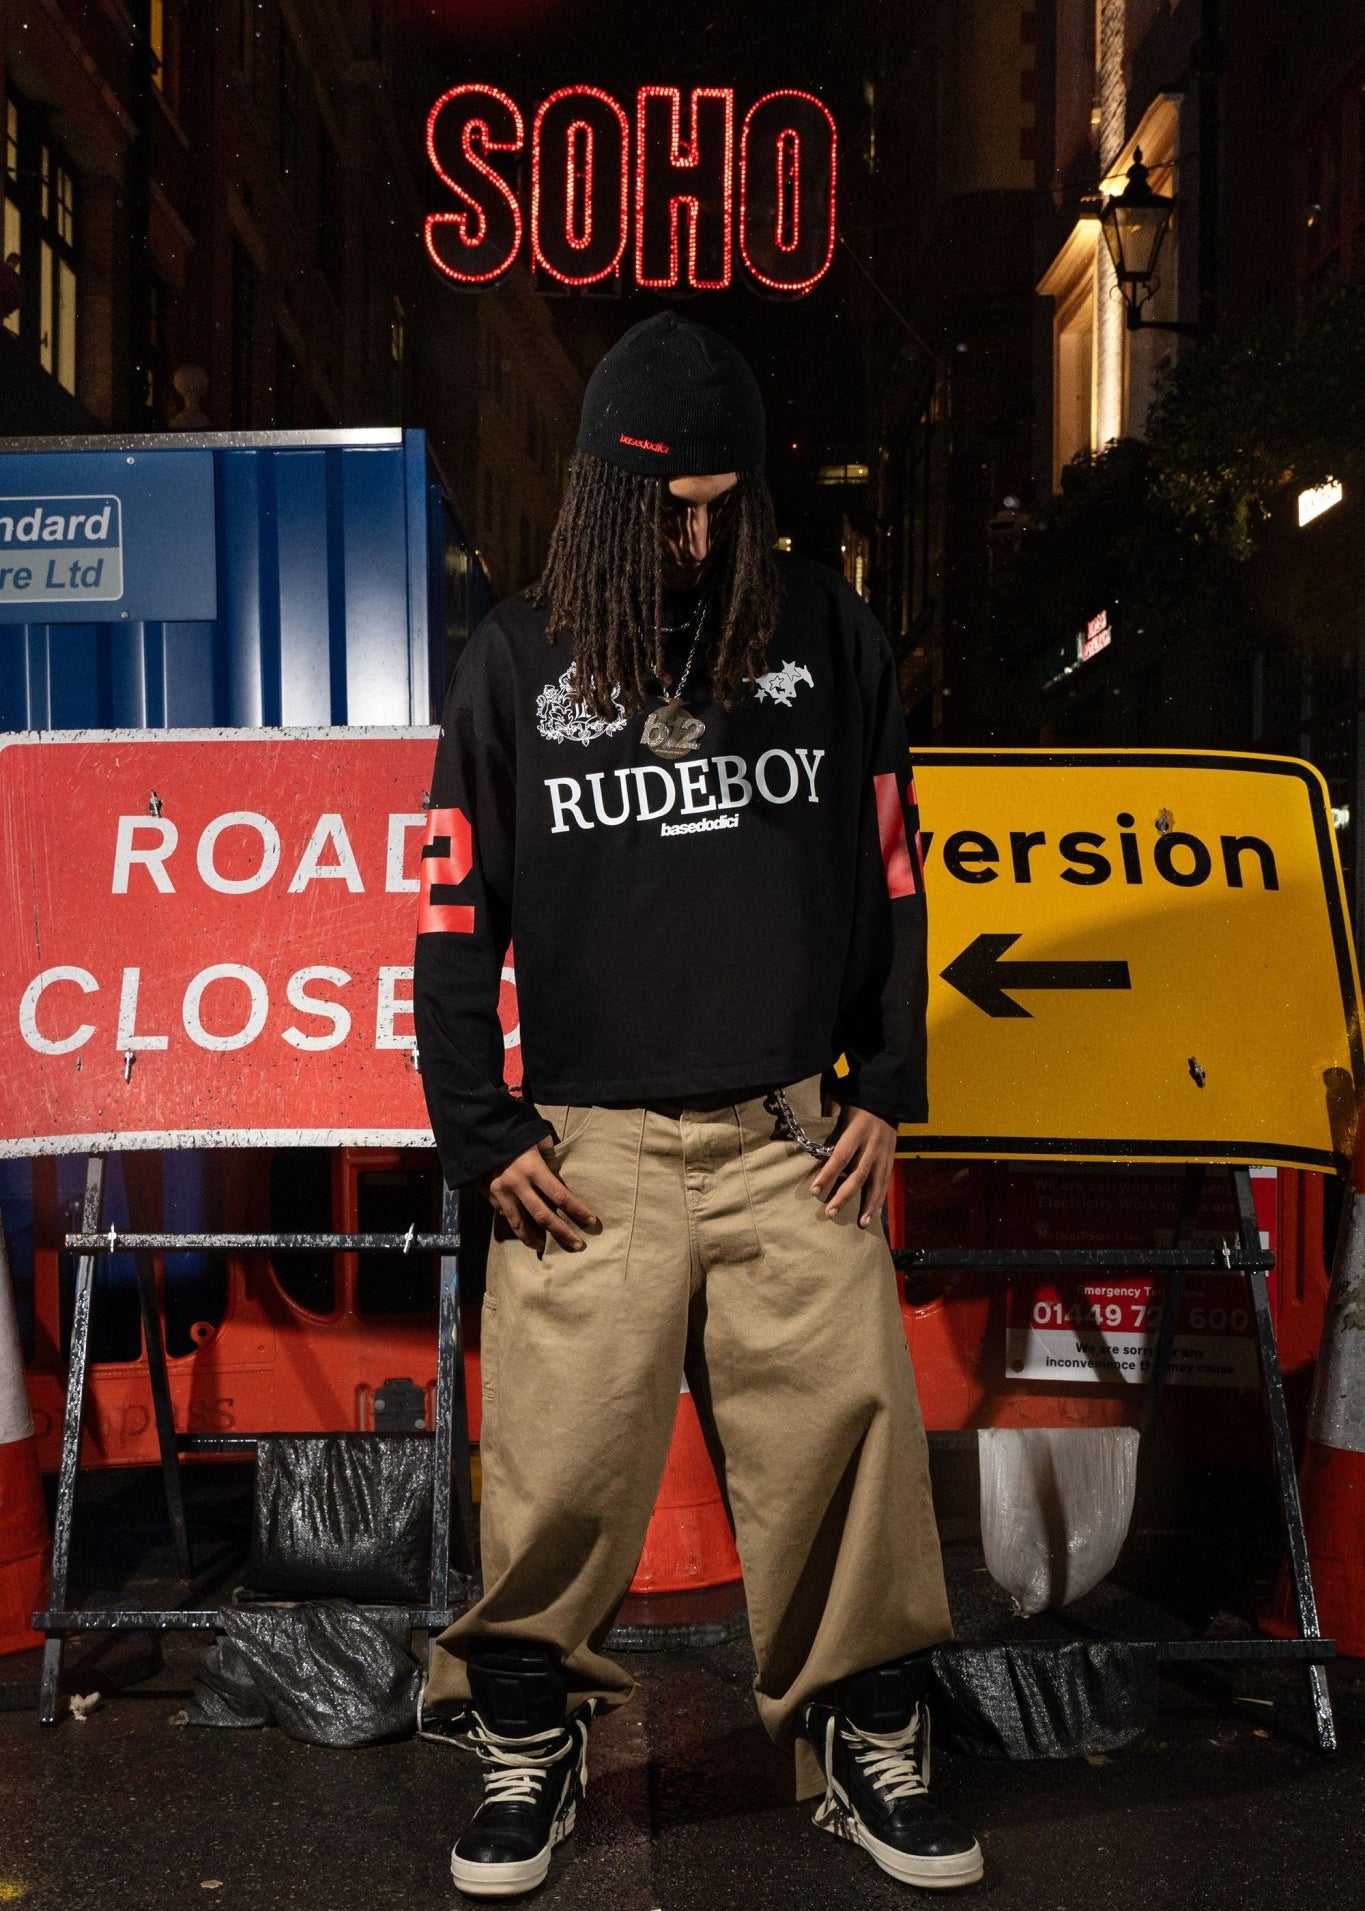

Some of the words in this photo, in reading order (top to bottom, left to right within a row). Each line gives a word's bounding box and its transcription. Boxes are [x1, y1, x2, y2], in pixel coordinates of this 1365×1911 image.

[425, 83, 838, 292] SOHO
[0, 506, 111, 542] ndard
[0, 566, 33, 590] re
[45, 558, 104, 588] Ltd
[544, 748, 825, 834] RUDEBOY
[660, 814, 739, 837] basedodici
[418, 808, 475, 935] 2
[19, 962, 521, 1056] CLOSE
[1033, 1301, 1122, 1327] 01449
[1189, 1307, 1248, 1331] 600
[1046, 1356, 1135, 1371] inconvenience
